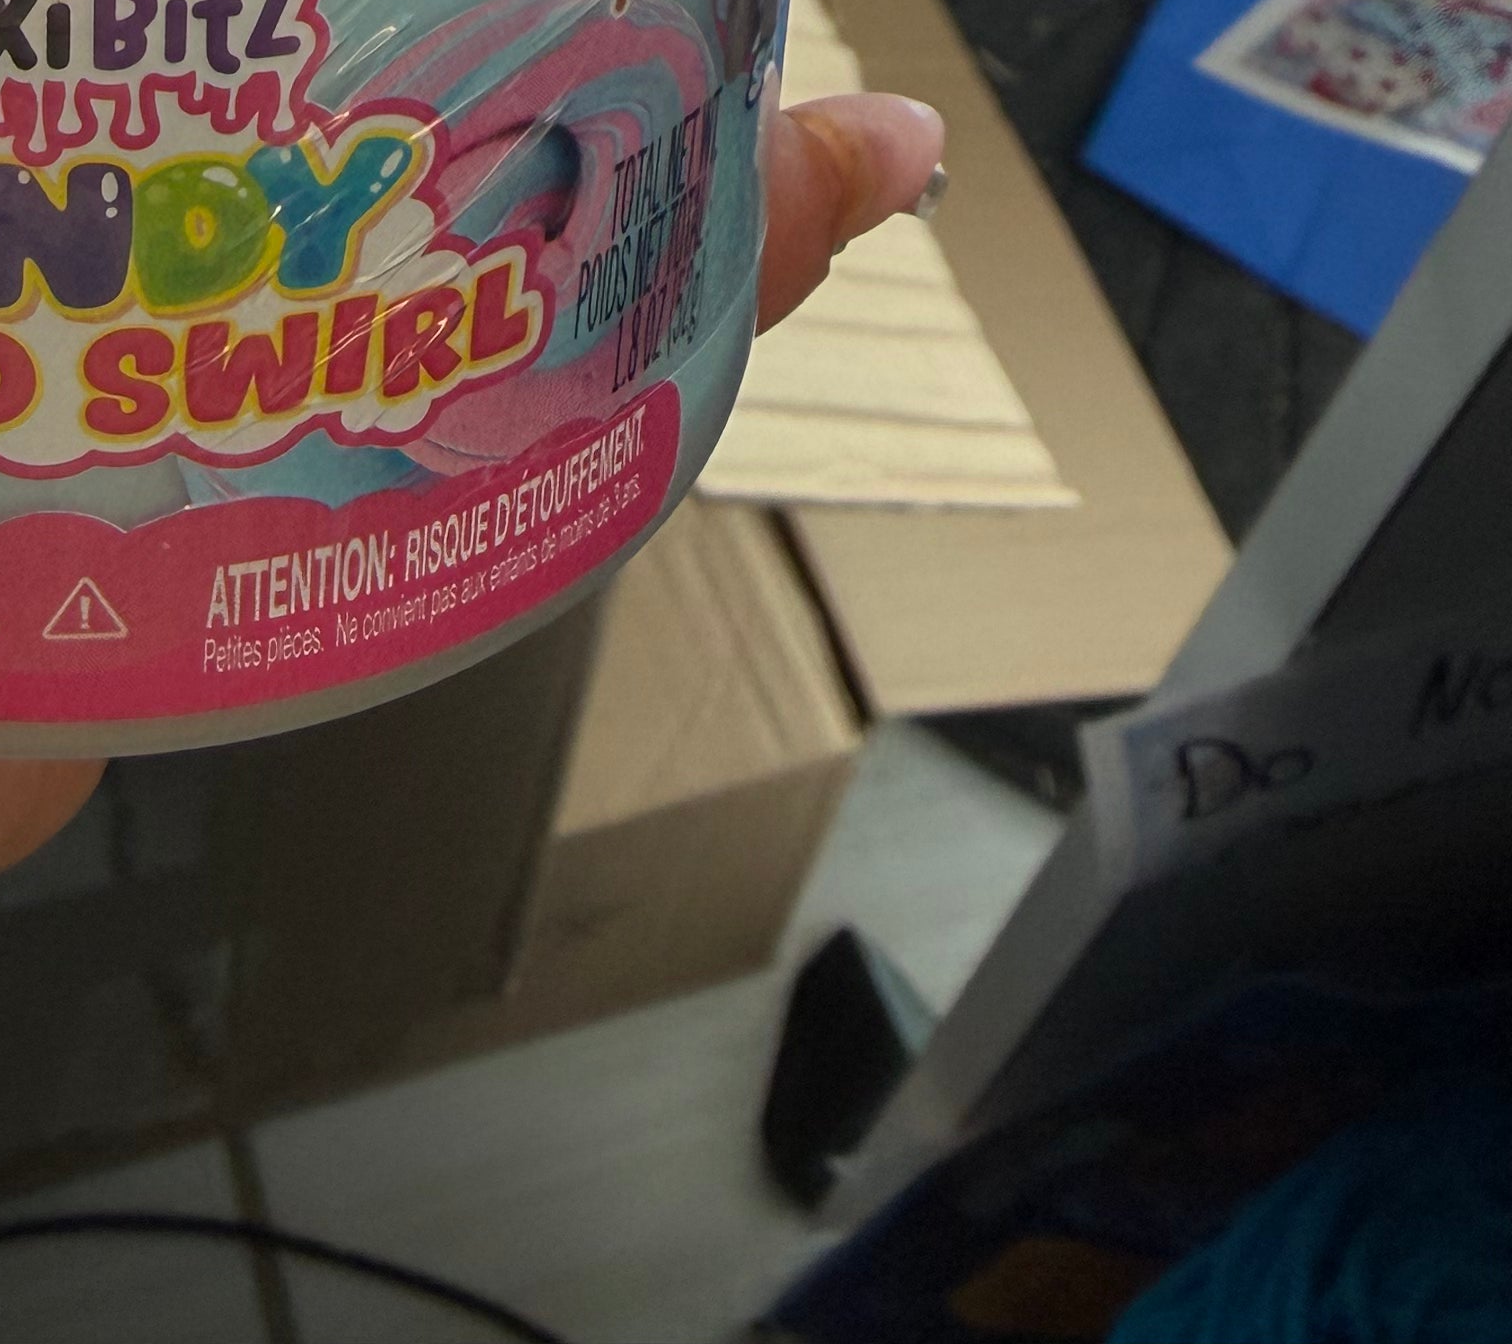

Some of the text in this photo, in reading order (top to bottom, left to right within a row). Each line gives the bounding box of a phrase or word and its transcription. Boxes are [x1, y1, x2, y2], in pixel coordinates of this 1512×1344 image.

[611, 135, 662, 242] TOTAL
[665, 106, 701, 208] NET
[574, 234, 631, 341] POIDS
[631, 210, 667, 304] NET
[644, 283, 668, 371] OZ
[81, 260, 532, 436] SWIRL
[203, 635, 263, 673] Petites
[267, 624, 325, 671] pièces.
[335, 612, 358, 647] Ne
[362, 590, 427, 641] convient
[430, 582, 458, 624] pas
[461, 569, 488, 604] aux
[490, 539, 538, 592] enfants
[541, 524, 557, 564] de
[205, 529, 397, 629] ATTENTION:
[404, 499, 491, 582] RISQUE
